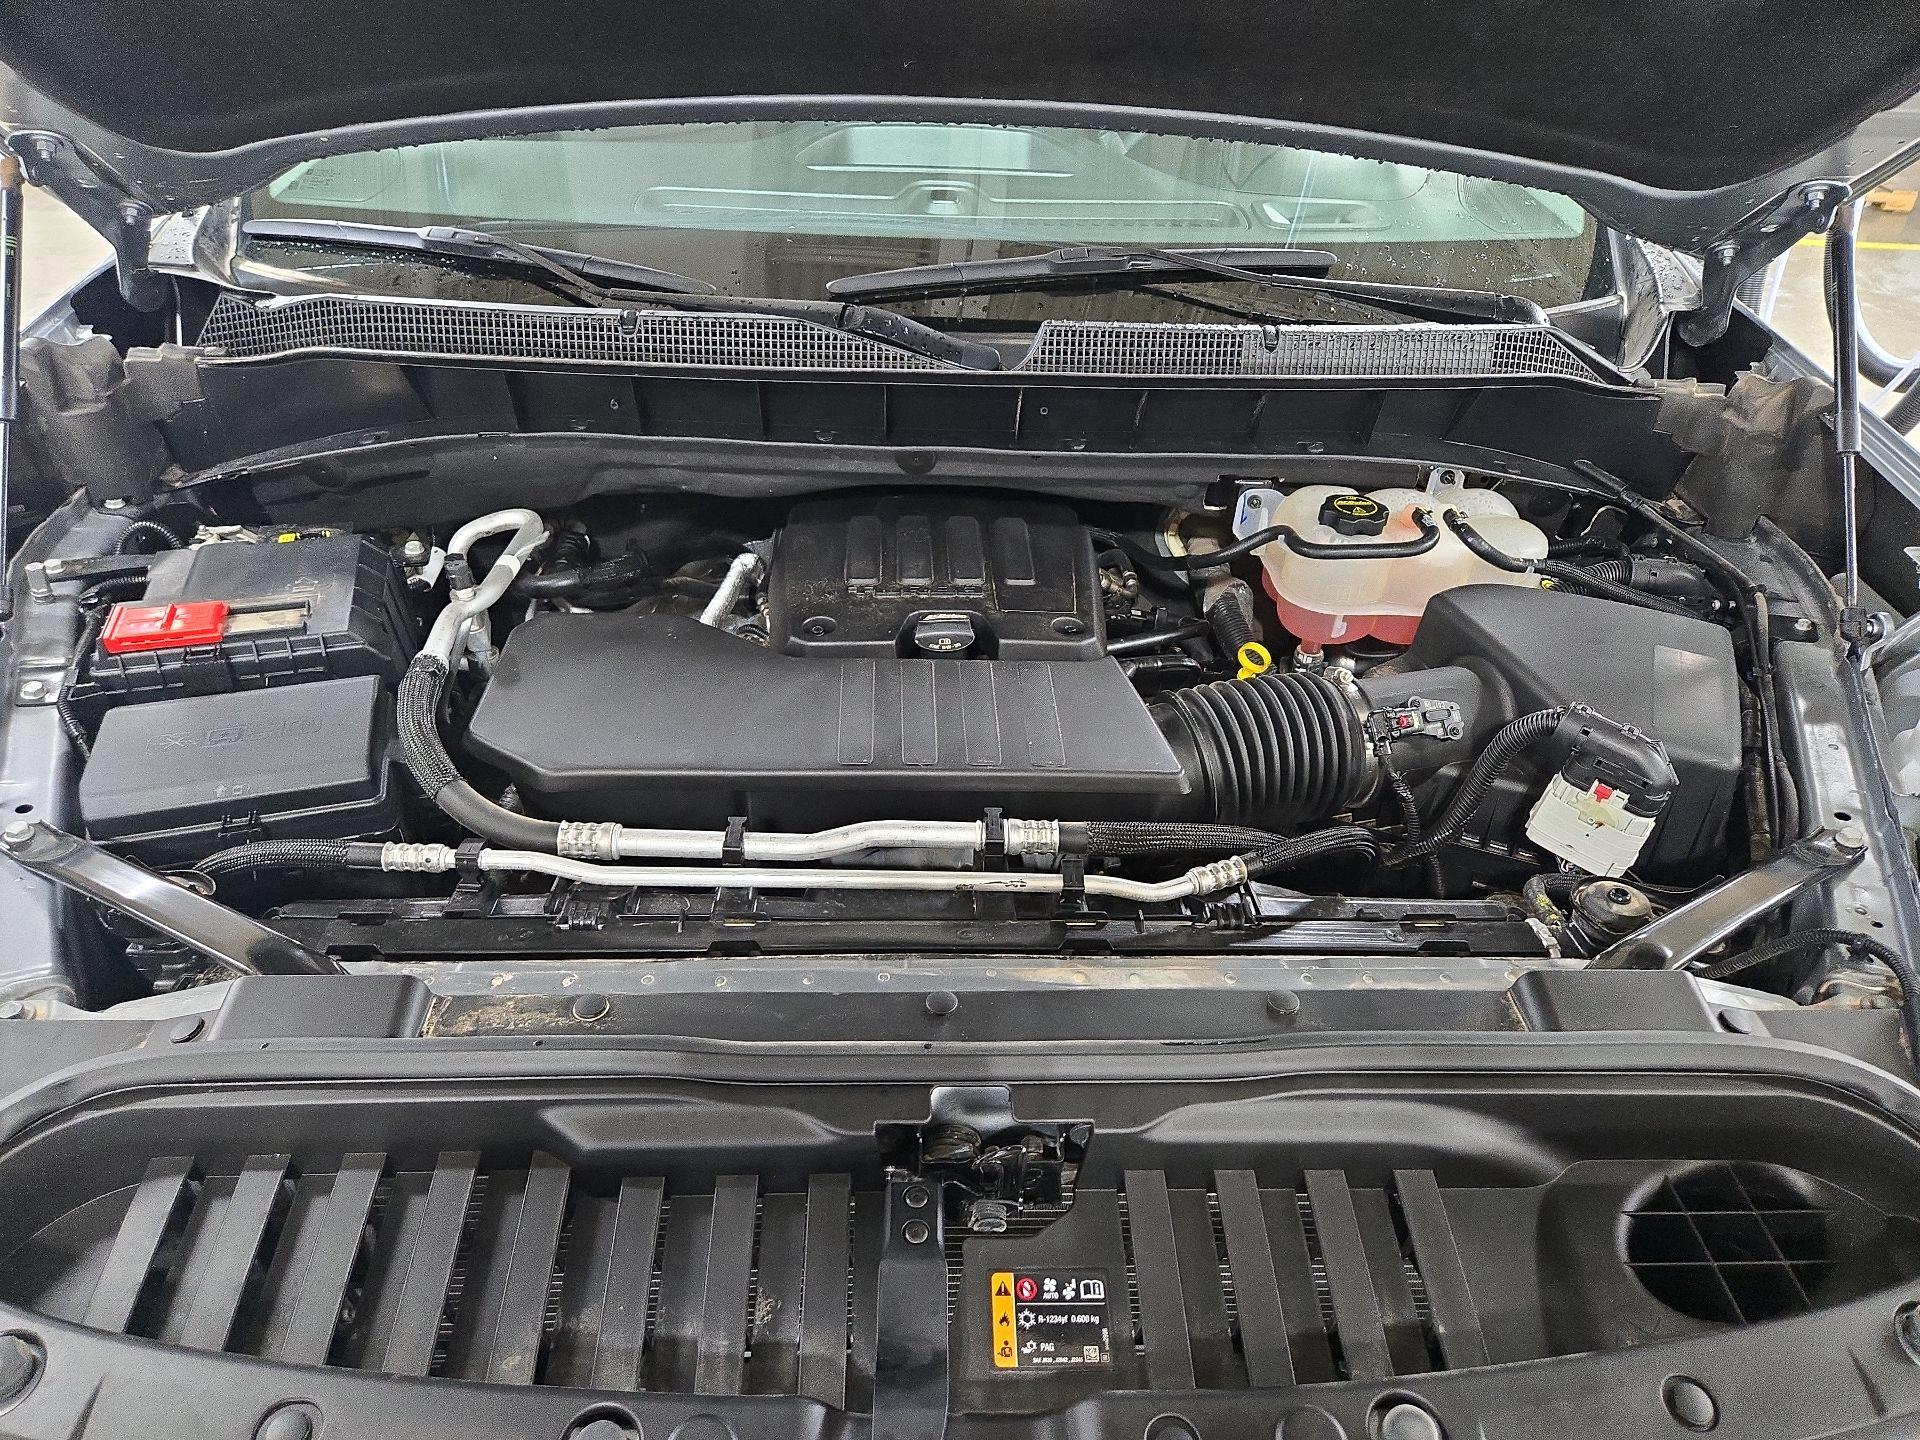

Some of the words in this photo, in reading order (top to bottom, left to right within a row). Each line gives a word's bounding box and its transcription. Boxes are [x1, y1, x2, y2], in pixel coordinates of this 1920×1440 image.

[847, 585, 985, 599] TURBO
[1038, 1315, 1068, 1325] R-1234yf
[1071, 1315, 1089, 1323] 0.600
[1091, 1315, 1100, 1324] kg
[1040, 1342, 1055, 1351] PAG
